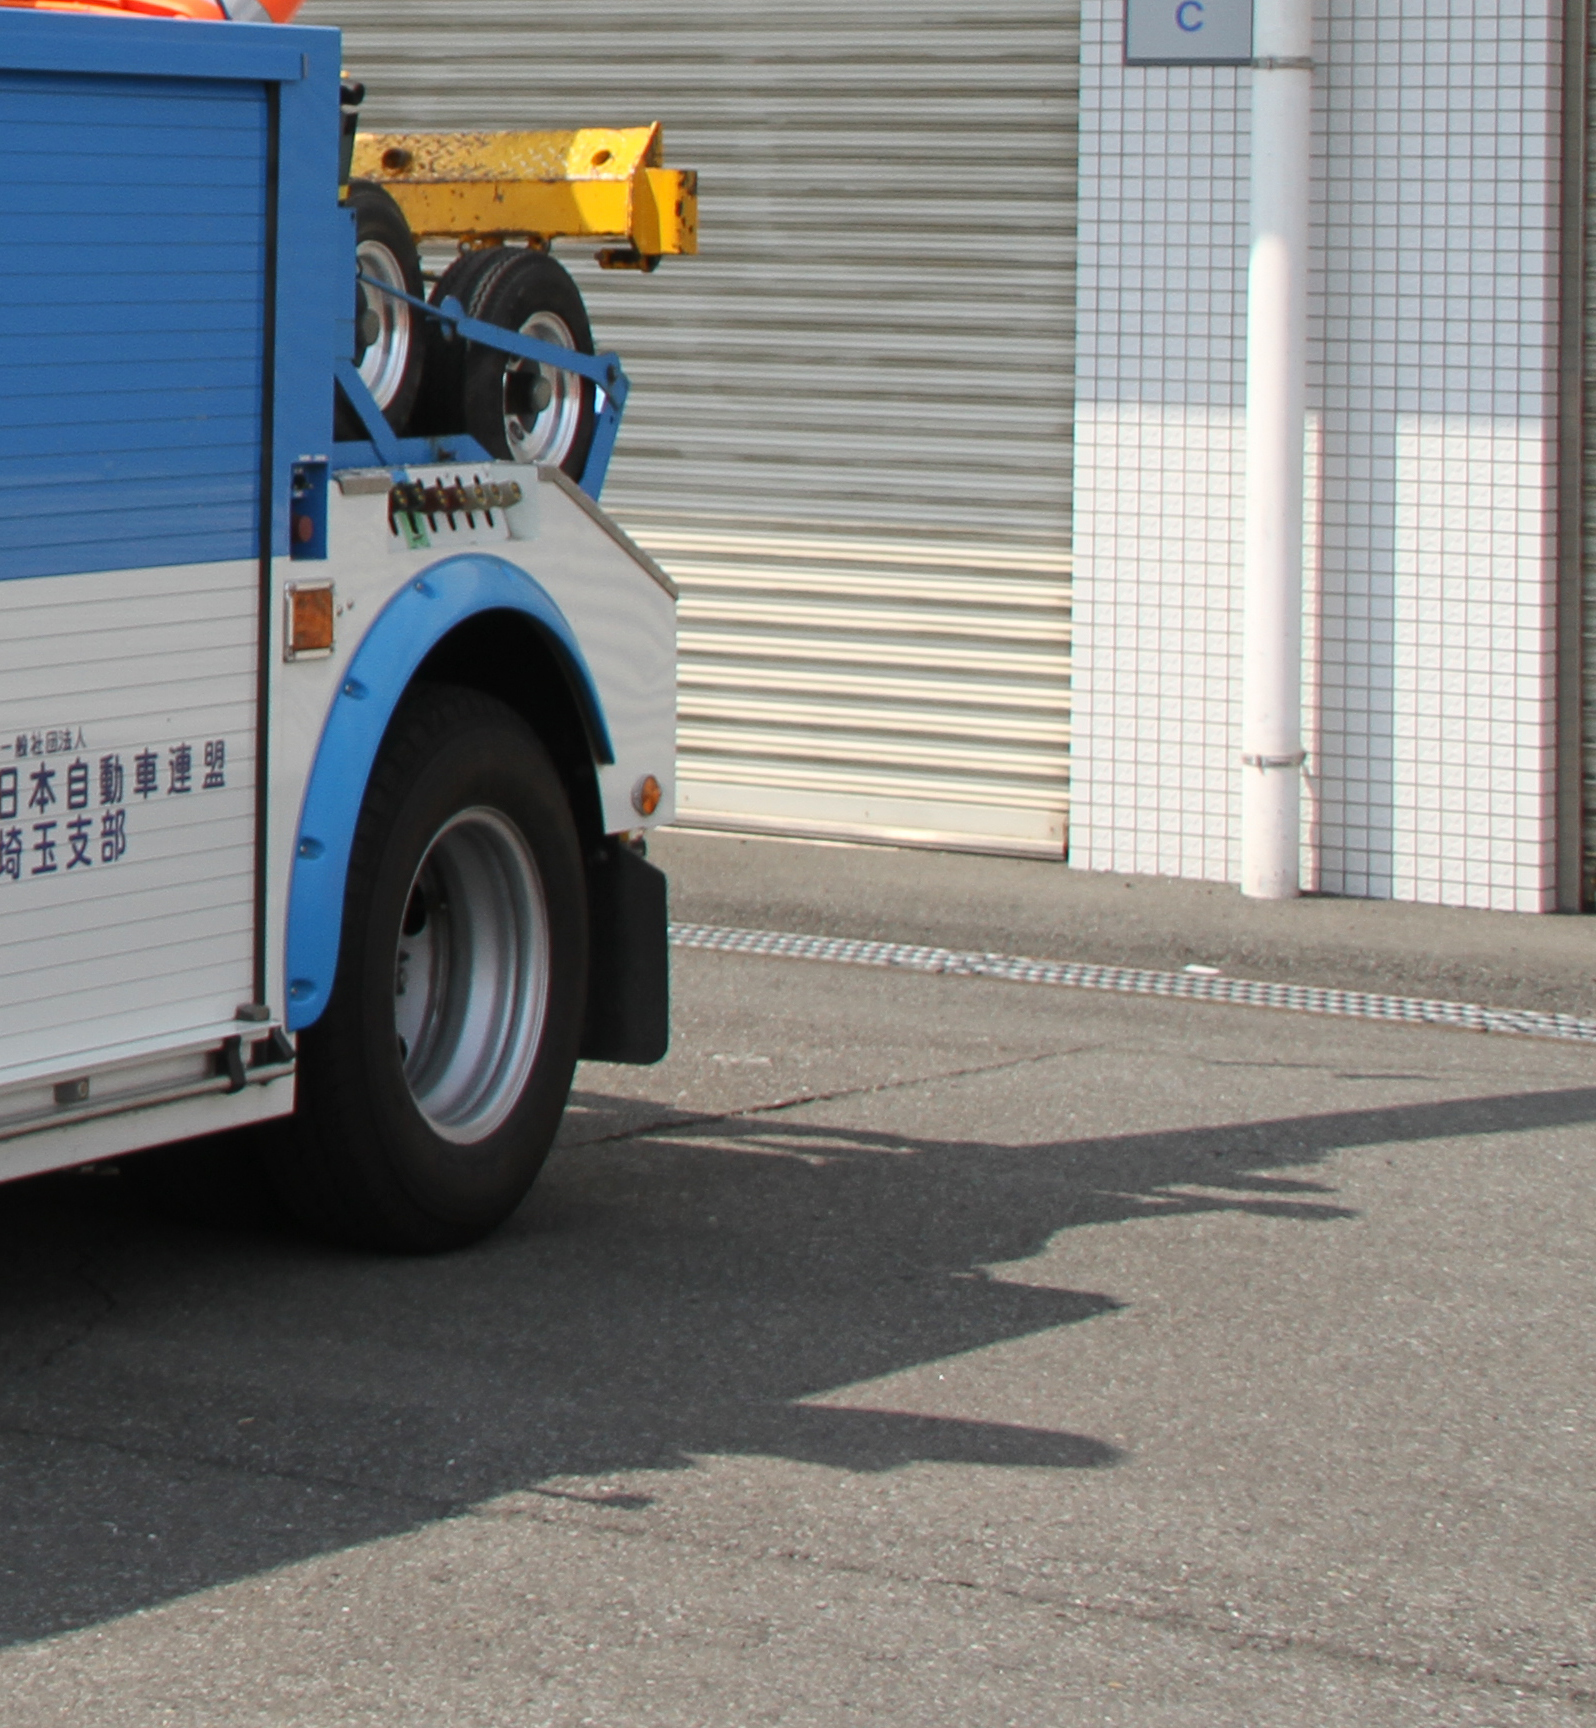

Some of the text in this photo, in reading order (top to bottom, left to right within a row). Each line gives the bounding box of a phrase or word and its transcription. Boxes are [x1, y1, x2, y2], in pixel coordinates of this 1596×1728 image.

[1175, 0, 1204, 32] C
[0, 726, 88, 759] 一般社団法人
